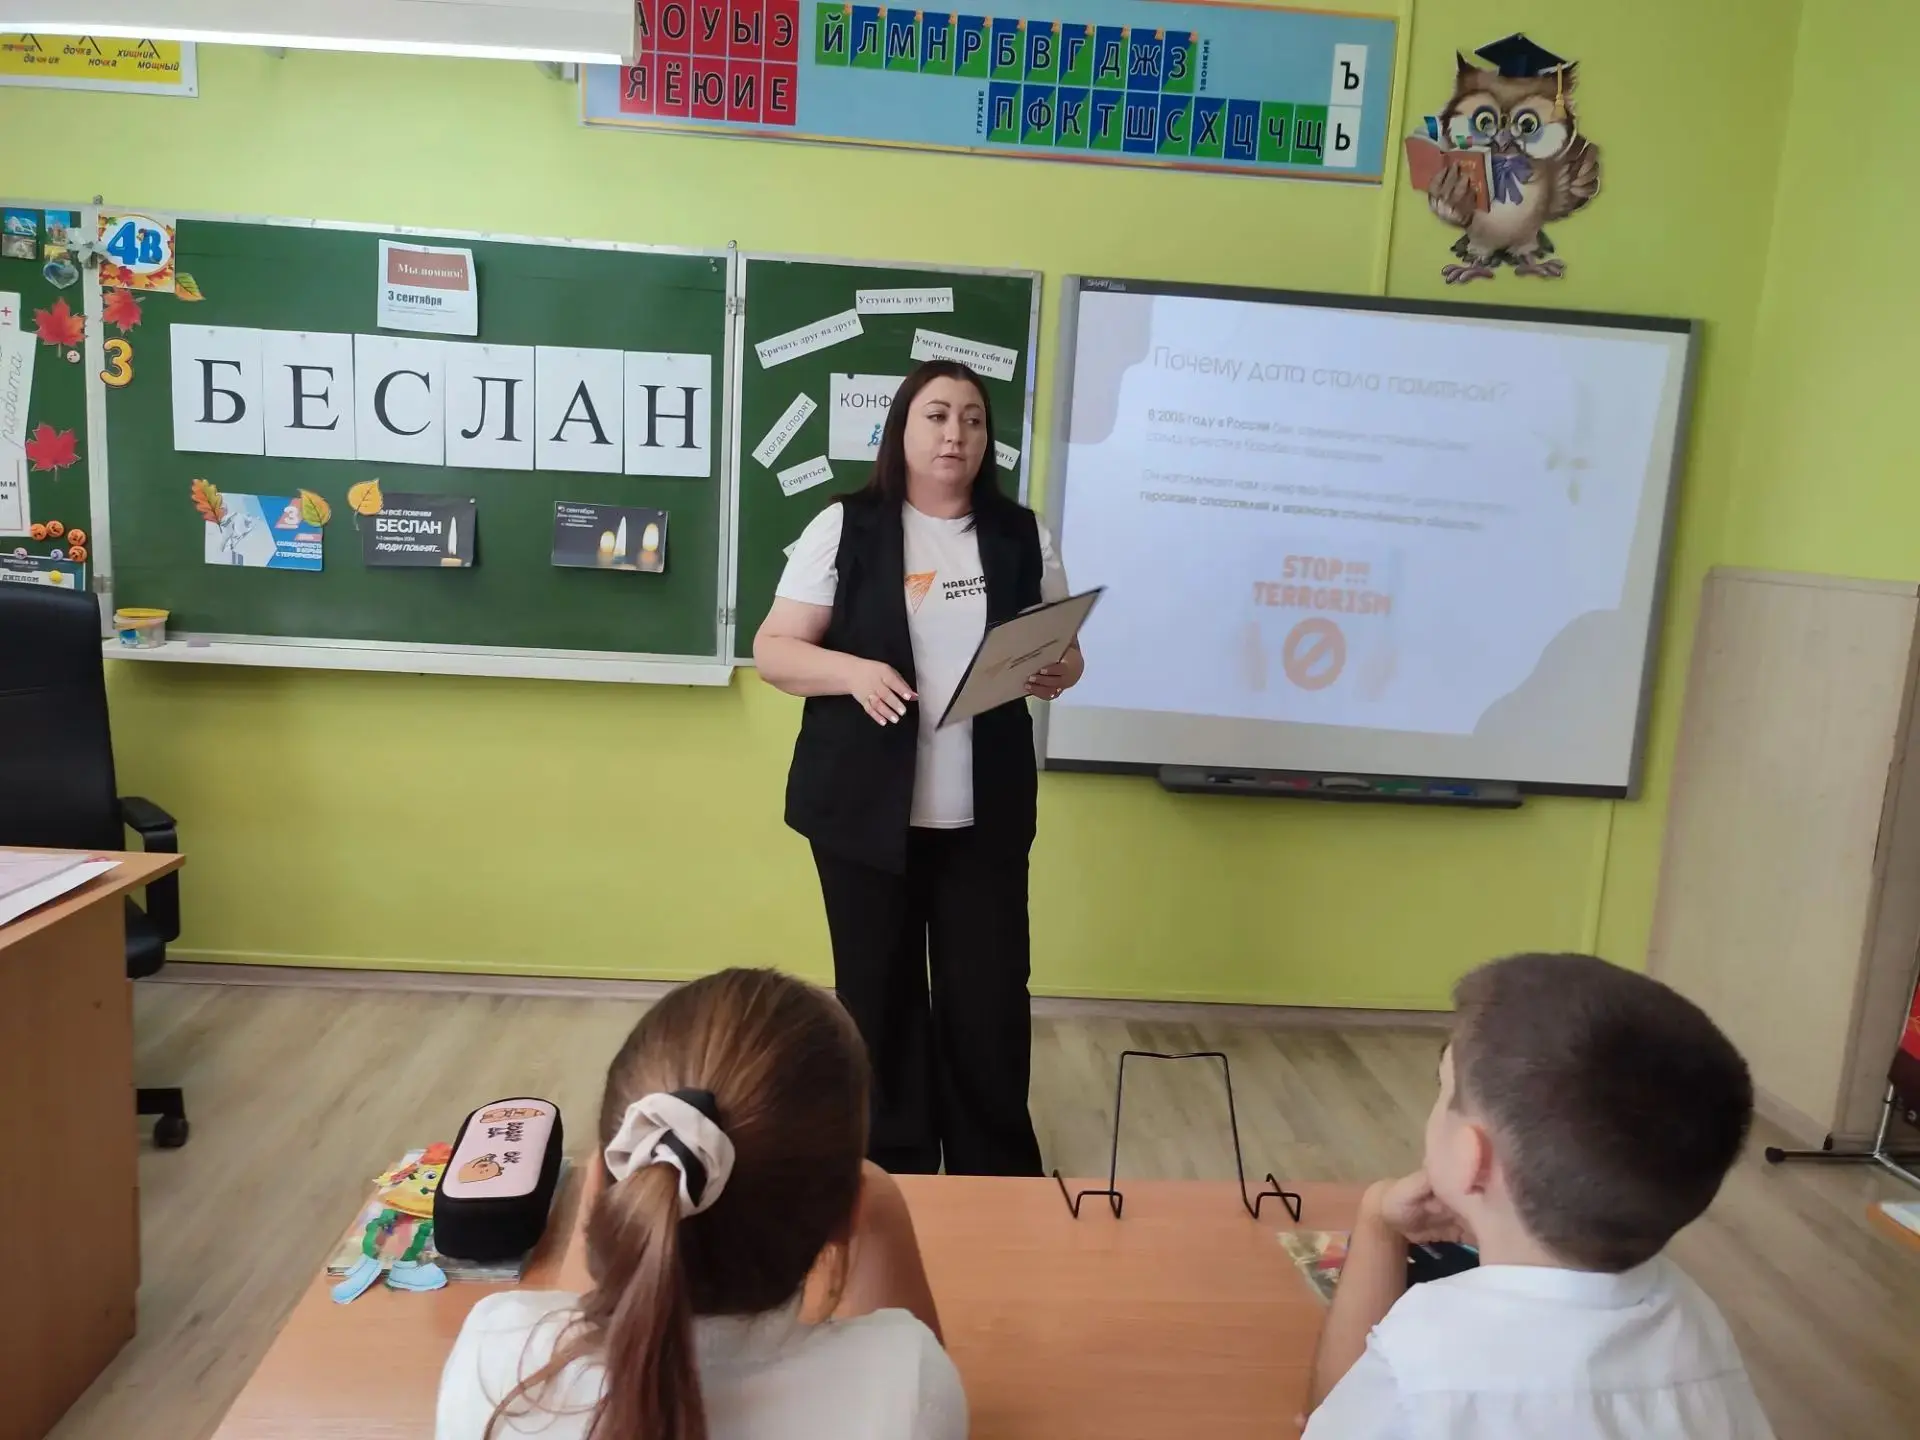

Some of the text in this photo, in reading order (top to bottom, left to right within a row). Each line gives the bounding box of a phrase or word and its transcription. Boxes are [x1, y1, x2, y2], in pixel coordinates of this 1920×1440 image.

[662, 2, 687, 40] О
[700, 7, 721, 42] У
[732, 11, 760, 46] Ы
[773, 14, 794, 47] Э
[823, 13, 844, 54] Й
[857, 22, 879, 54] Л
[888, 24, 915, 60] М
[927, 26, 949, 61] Н
[963, 29, 983, 64] Р
[998, 32, 1017, 68] Б
[1031, 35, 1052, 71] В
[1067, 38, 1086, 72] Г
[1099, 41, 1121, 79] Д
[1130, 44, 1161, 78] Ж
[625, 62, 789, 112] Я Ё Ю И Е
[1340, 60, 1361, 91] Ъ
[993, 96, 1352, 159] П Ф К Т Ш С Х Ц Ч Щ Ь
[387, 290, 443, 306] 3 сентября
[100, 337, 133, 388] 3
[944, 344, 980, 358] ставить
[1153, 345, 1243, 383] Почему
[1247, 362, 1306, 384] дата
[1312, 368, 1380, 392] стала
[194, 357, 703, 450] БЕСЛАН
[840, 393, 892, 409] КОНФ
[781, 465, 828, 489] Ссориться
[375, 518, 442, 535] БЕСЛАН
[942, 576, 985, 589] НАВИГА
[1251, 580, 1393, 617] TERRORISM
